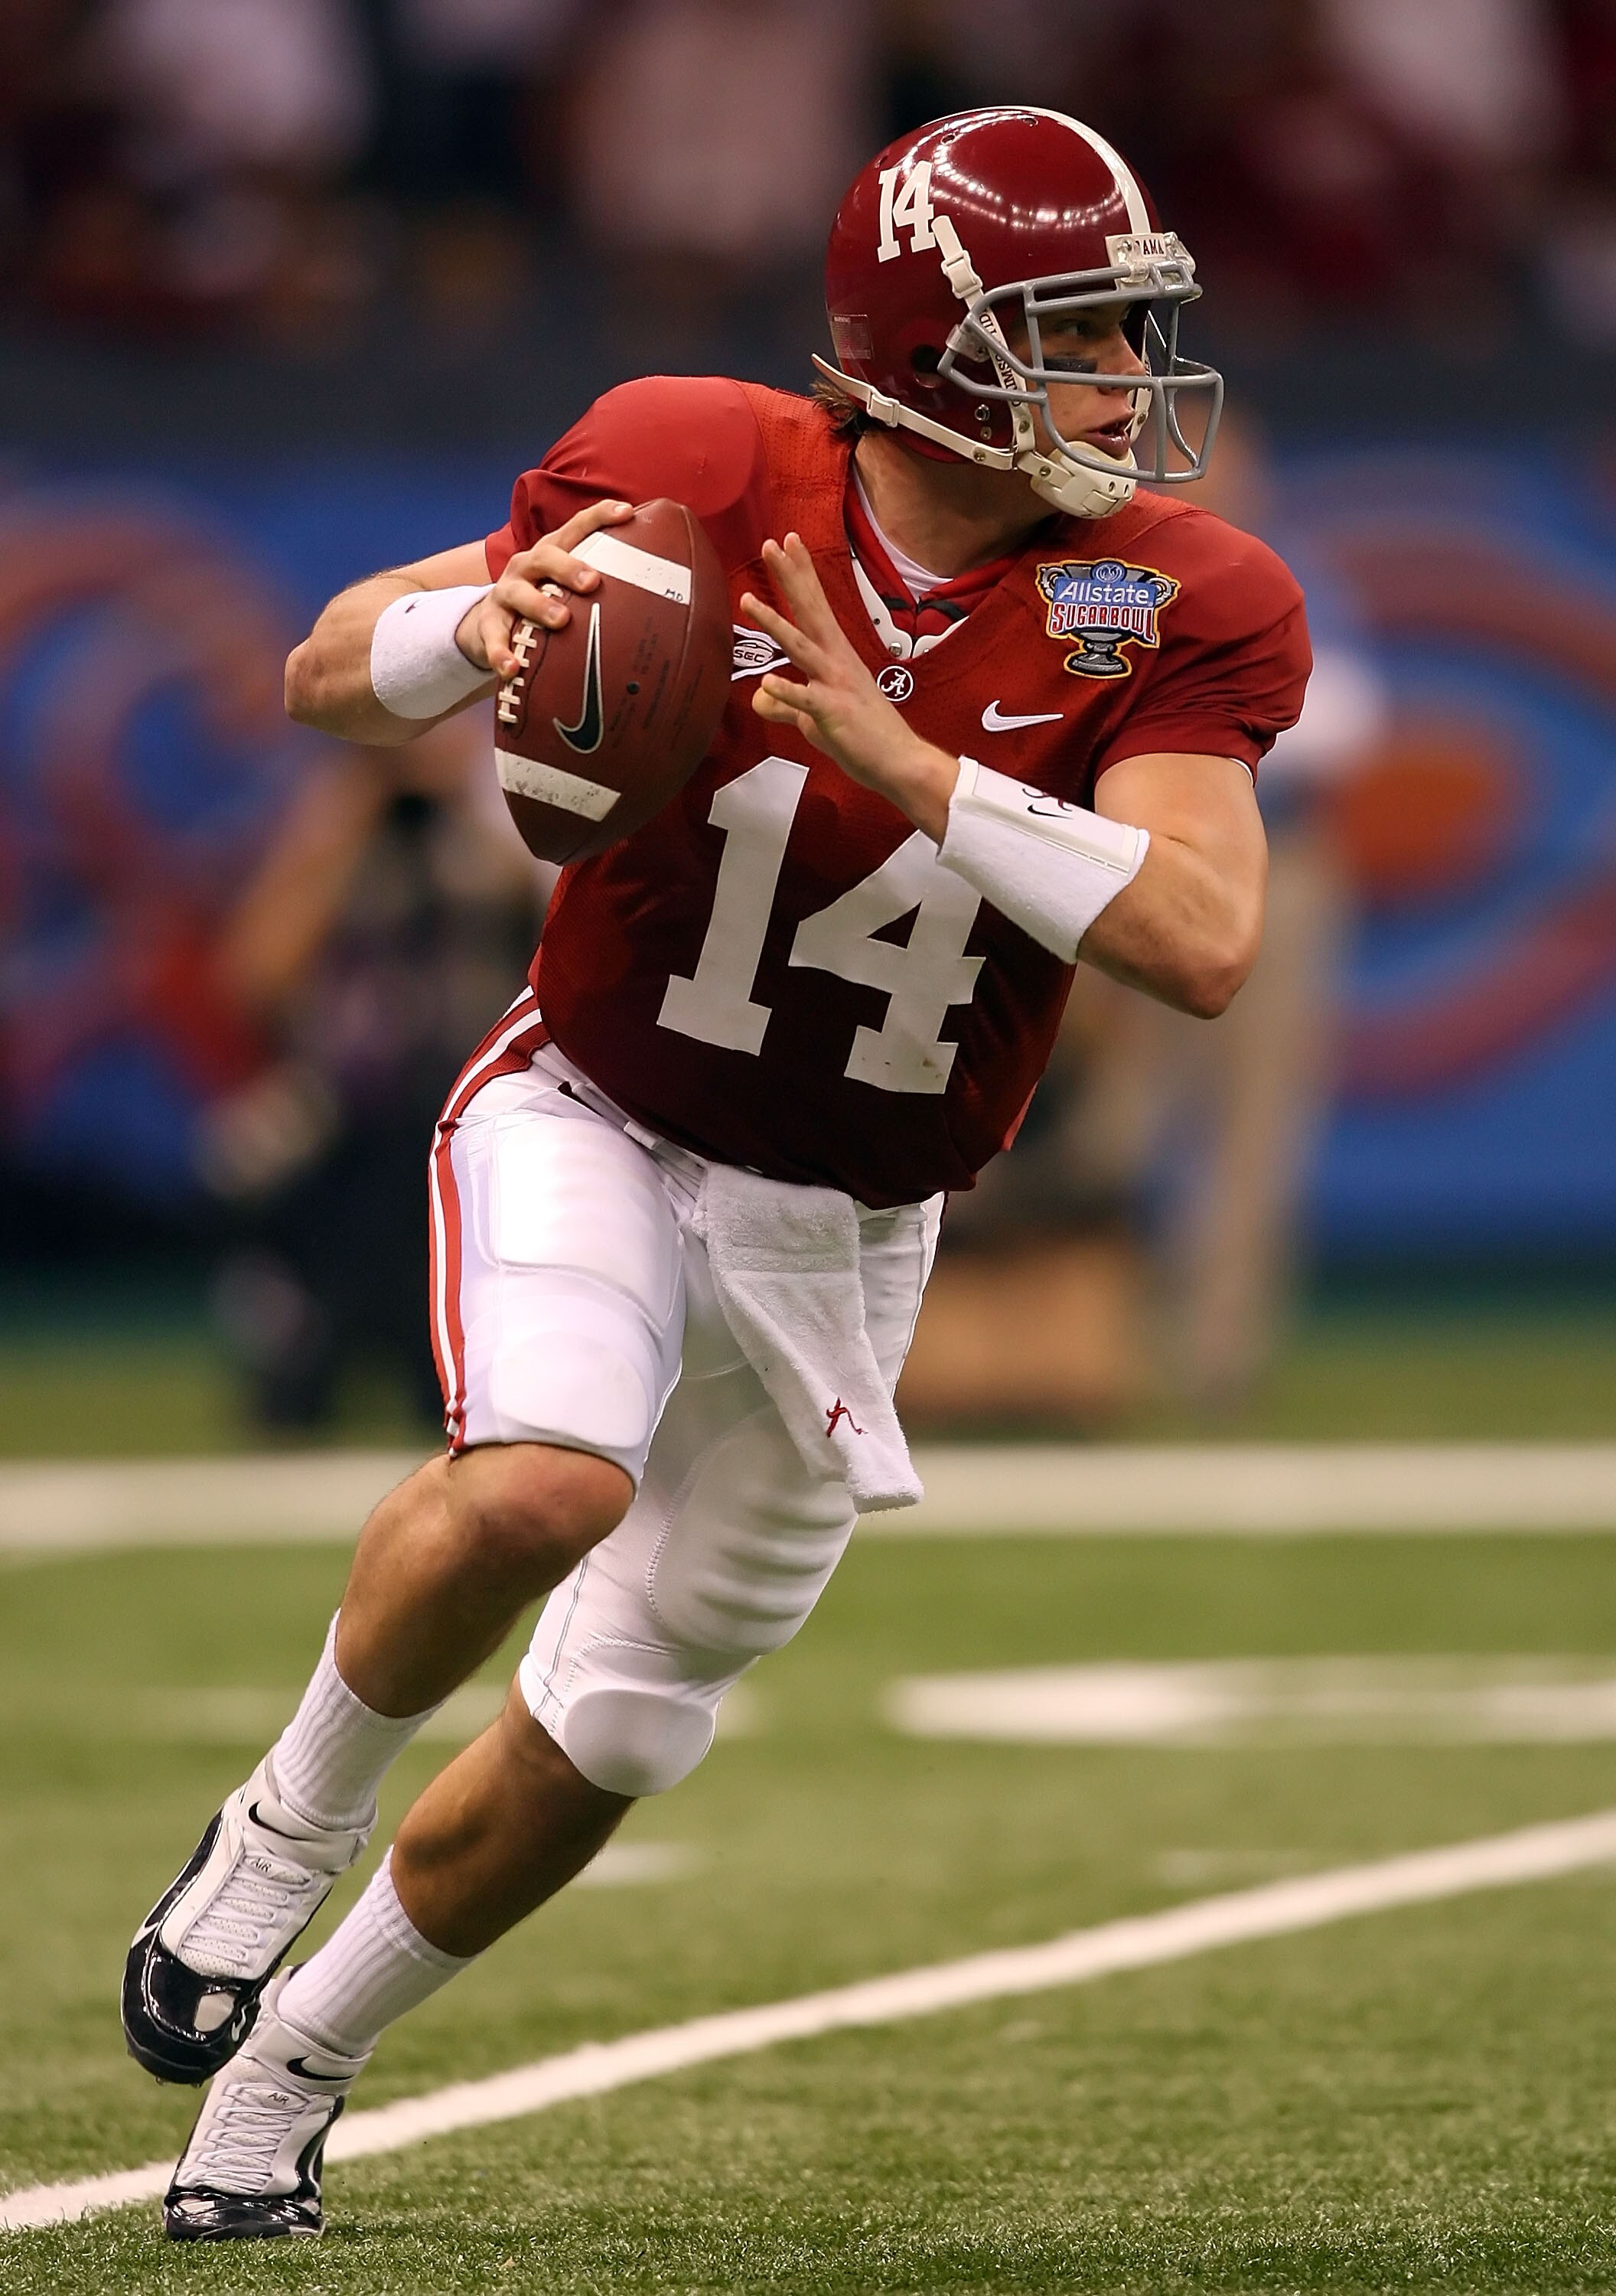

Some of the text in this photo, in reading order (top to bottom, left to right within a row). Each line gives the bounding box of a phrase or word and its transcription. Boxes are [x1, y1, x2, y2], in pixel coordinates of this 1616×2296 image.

[877, 160, 937, 263] 14
[1135, 239, 1165, 255] AMA
[1057, 581, 1149, 604] Allstate
[733, 649, 765, 664] SEC
[656, 755, 987, 1094] 14
[268, 2092, 290, 2105] AIR
